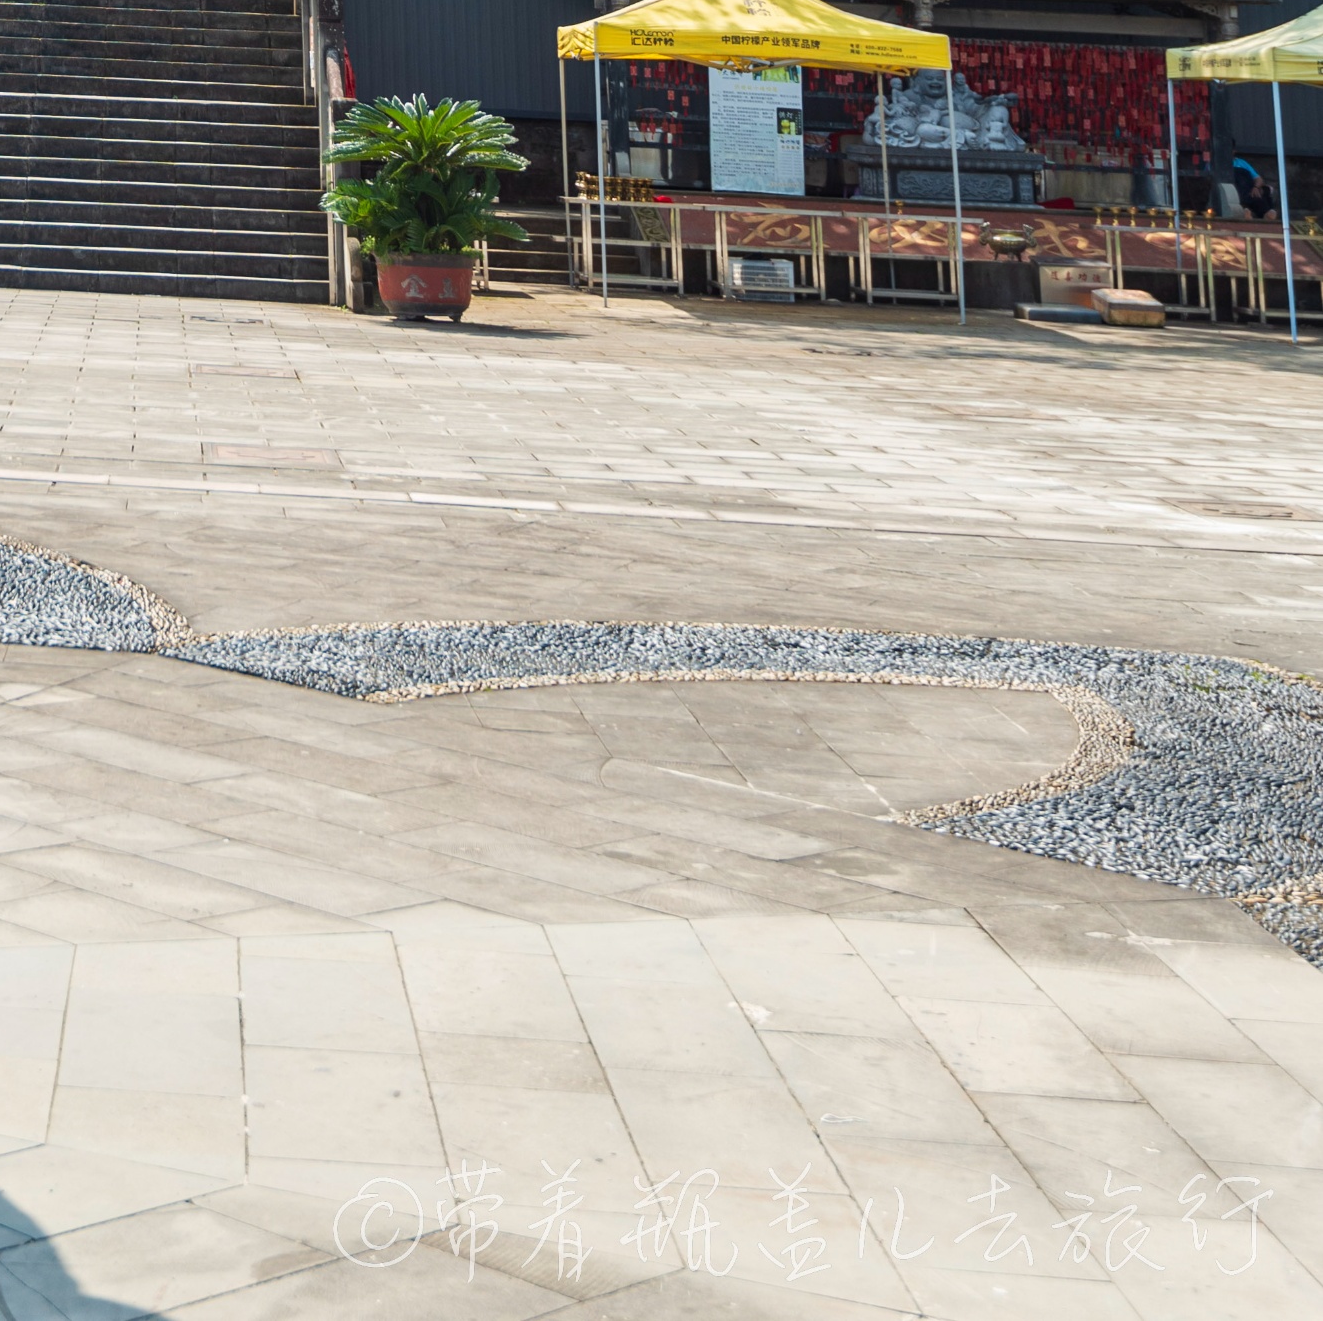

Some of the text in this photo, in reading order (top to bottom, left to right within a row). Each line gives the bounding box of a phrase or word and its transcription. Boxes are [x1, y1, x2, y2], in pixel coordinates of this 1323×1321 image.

[721, 34, 821, 51] 中国柠檬产业领军品牌
